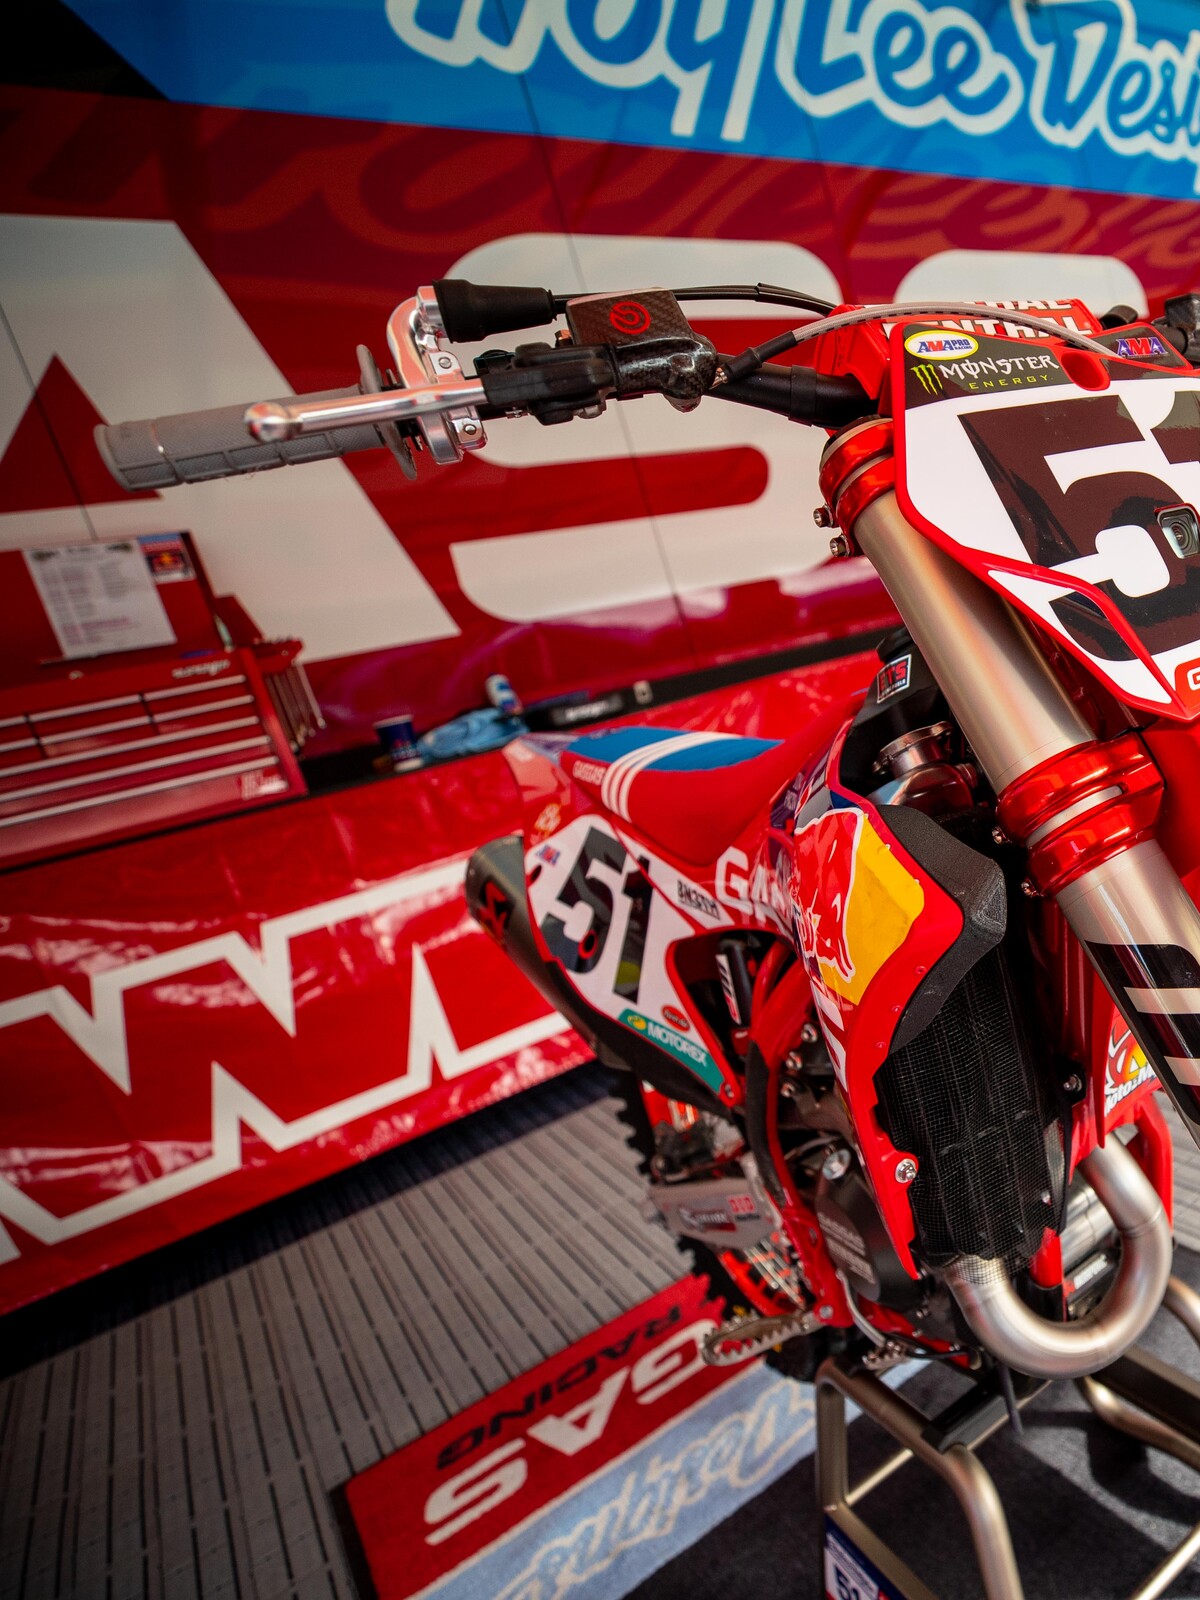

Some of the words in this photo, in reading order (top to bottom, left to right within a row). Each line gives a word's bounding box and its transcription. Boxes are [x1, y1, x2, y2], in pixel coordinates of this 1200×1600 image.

[917, 340, 951, 353] AMA
[952, 339, 971, 348] PRO
[1115, 337, 1168, 358] AMA
[939, 354, 1060, 380] MONSTER
[968, 374, 1049, 390] ENERGY
[540, 826, 655, 1006] 51
[647, 1021, 708, 1068] MOTOREX
